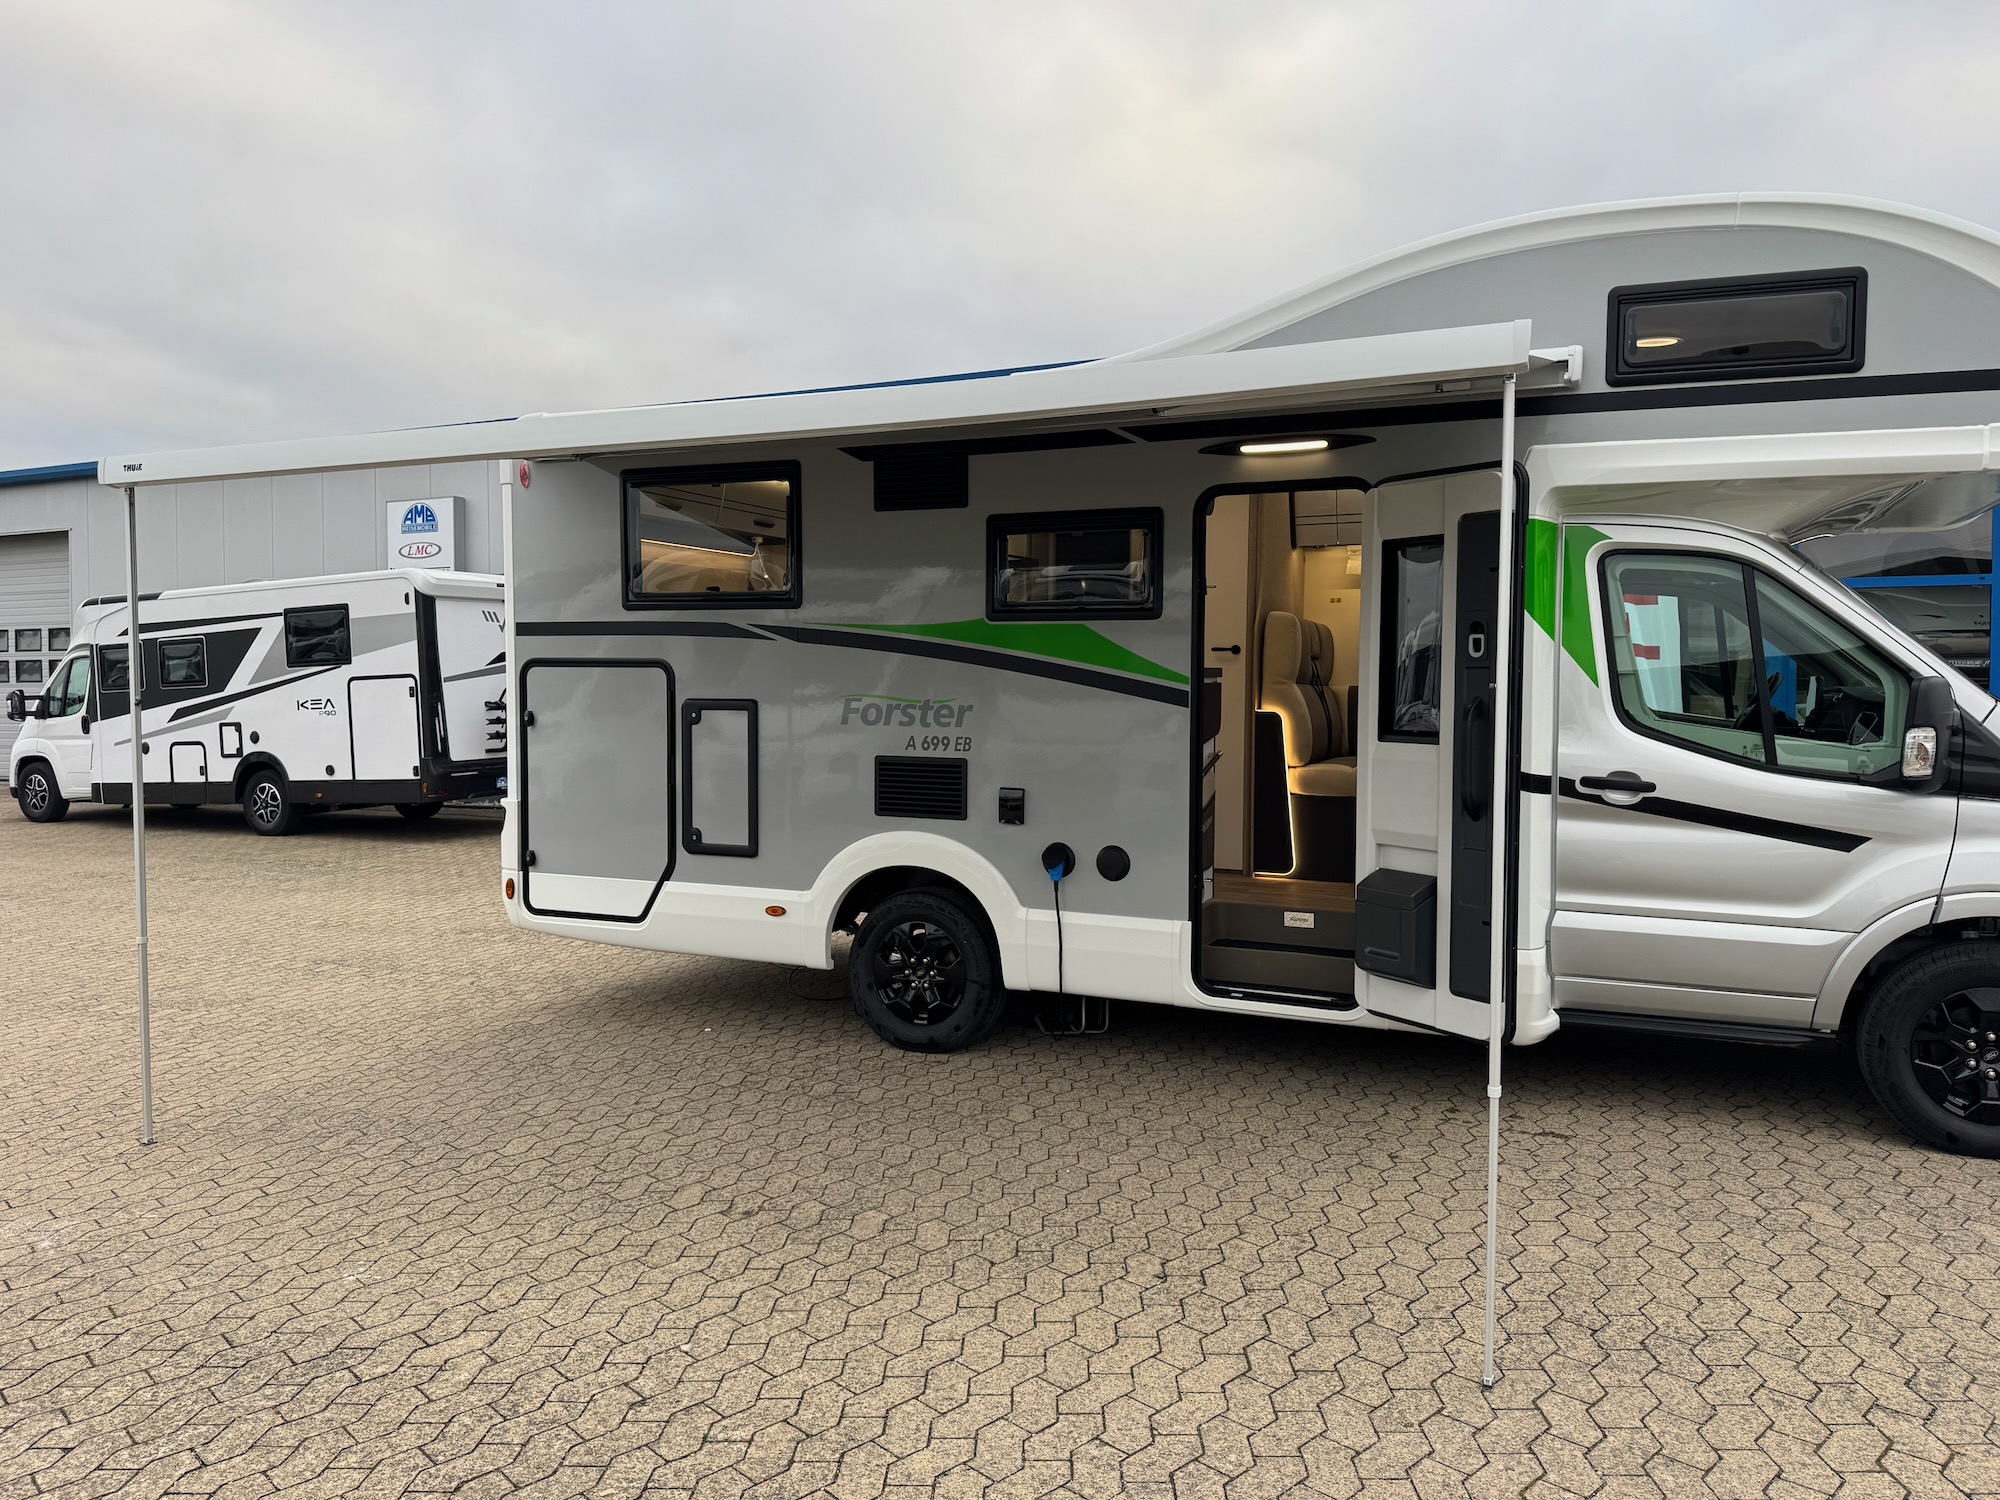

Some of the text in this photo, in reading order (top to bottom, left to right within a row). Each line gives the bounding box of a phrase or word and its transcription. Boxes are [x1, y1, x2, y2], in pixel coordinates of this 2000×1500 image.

[123, 463, 143, 472] THULE
[403, 504, 436, 524] AMB
[407, 544, 433, 556] LMC
[296, 698, 335, 711] KEA
[840, 698, 974, 728] Forster
[905, 735, 972, 752] A 699 EB
